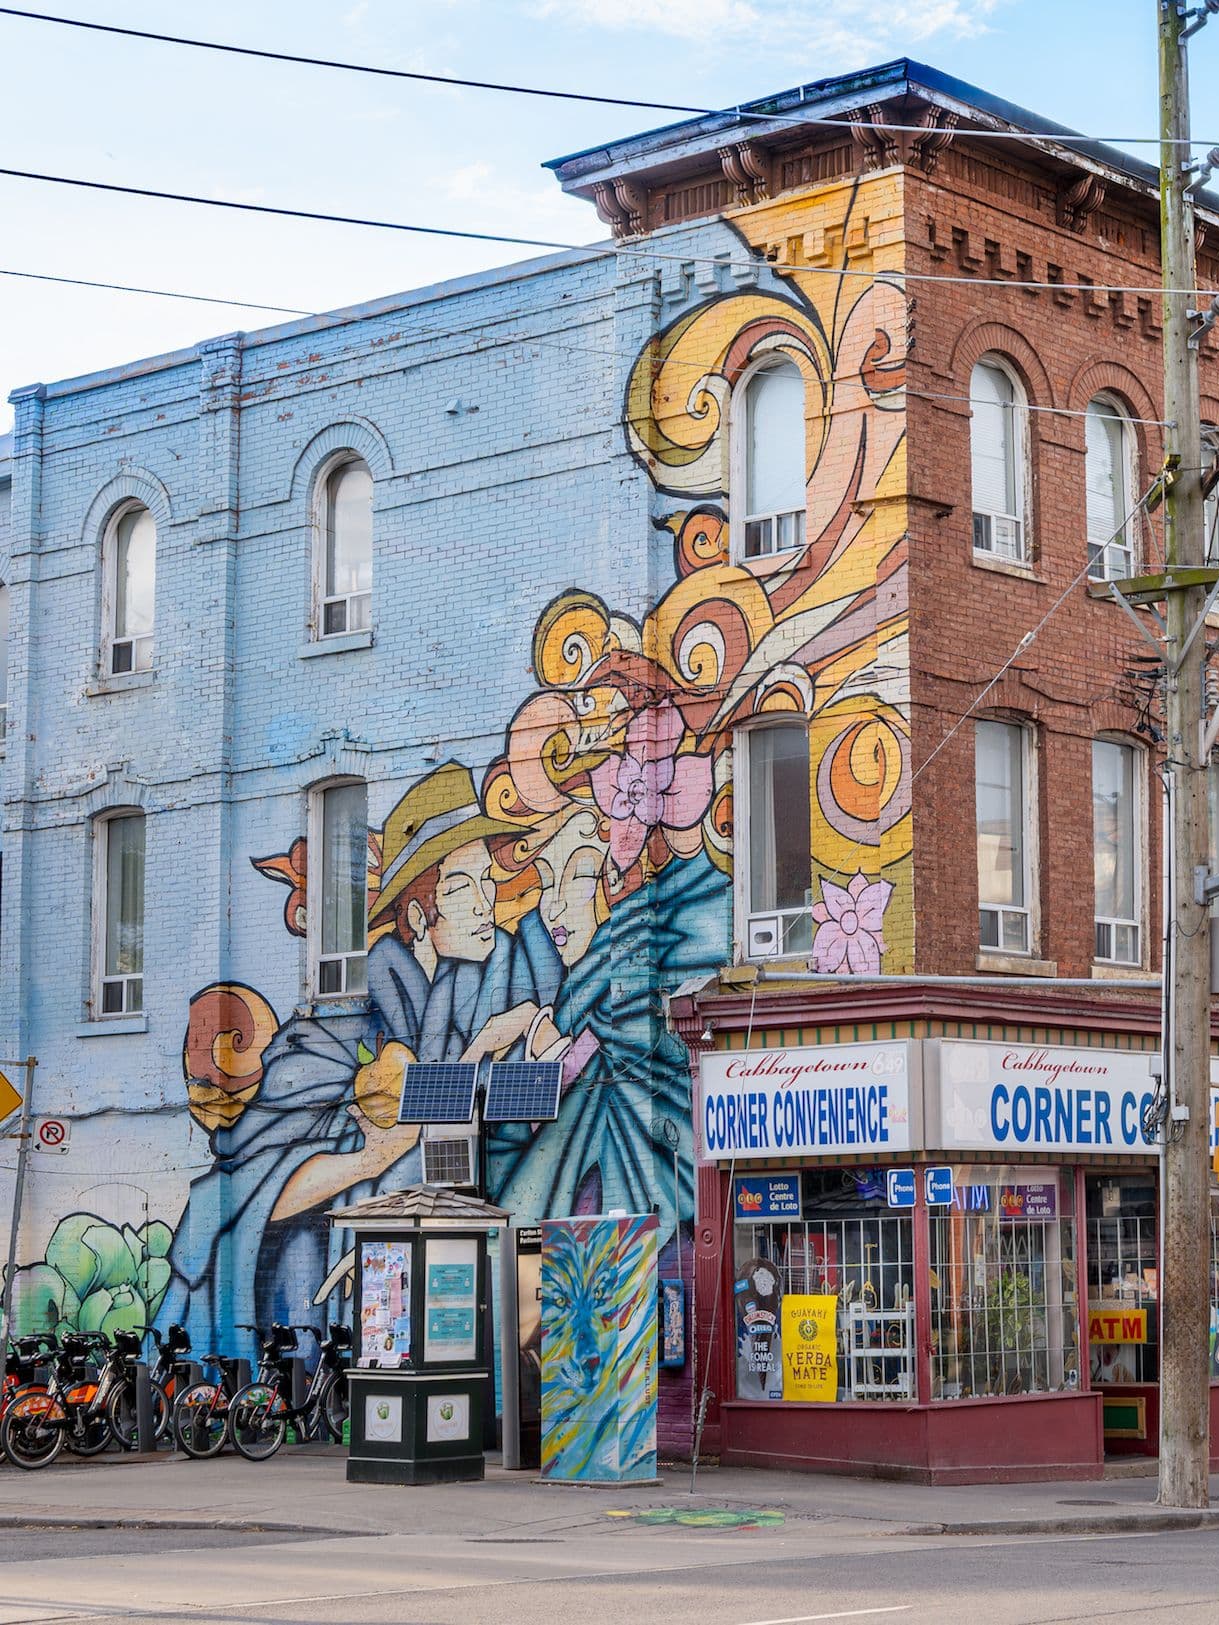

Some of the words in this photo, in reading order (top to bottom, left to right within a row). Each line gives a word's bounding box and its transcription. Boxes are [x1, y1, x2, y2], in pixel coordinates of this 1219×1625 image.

[725, 1051, 869, 1089] Cabbagetown
[1001, 1049, 1109, 1086] Cabbagetown
[705, 1093, 769, 1150] CORNER
[772, 1085, 889, 1148] CONVENIENCE
[990, 1083, 1113, 1145] CORNER
[768, 1182, 789, 1192] Lotto
[894, 1183, 914, 1193] Phone
[931, 1181, 951, 1191] Phone
[1026, 1185, 1044, 1193] Lotto
[769, 1192, 794, 1202] Centre
[1026, 1194, 1048, 1204] Centre
[769, 1202, 780, 1211] de
[780, 1201, 798, 1211] Loto
[1026, 1206, 1035, 1215] de
[1036, 1206, 1051, 1215] Loto
[790, 1308, 827, 1319] GUAYAKI
[1089, 1317, 1142, 1340] ATM
[753, 1341, 768, 1352] THE
[750, 1352, 774, 1362] FOMO
[786, 1351, 832, 1368] YERBA
[748, 1363, 758, 1372] IS
[757, 1362, 776, 1372] REAL
[792, 1366, 828, 1380] MATE
